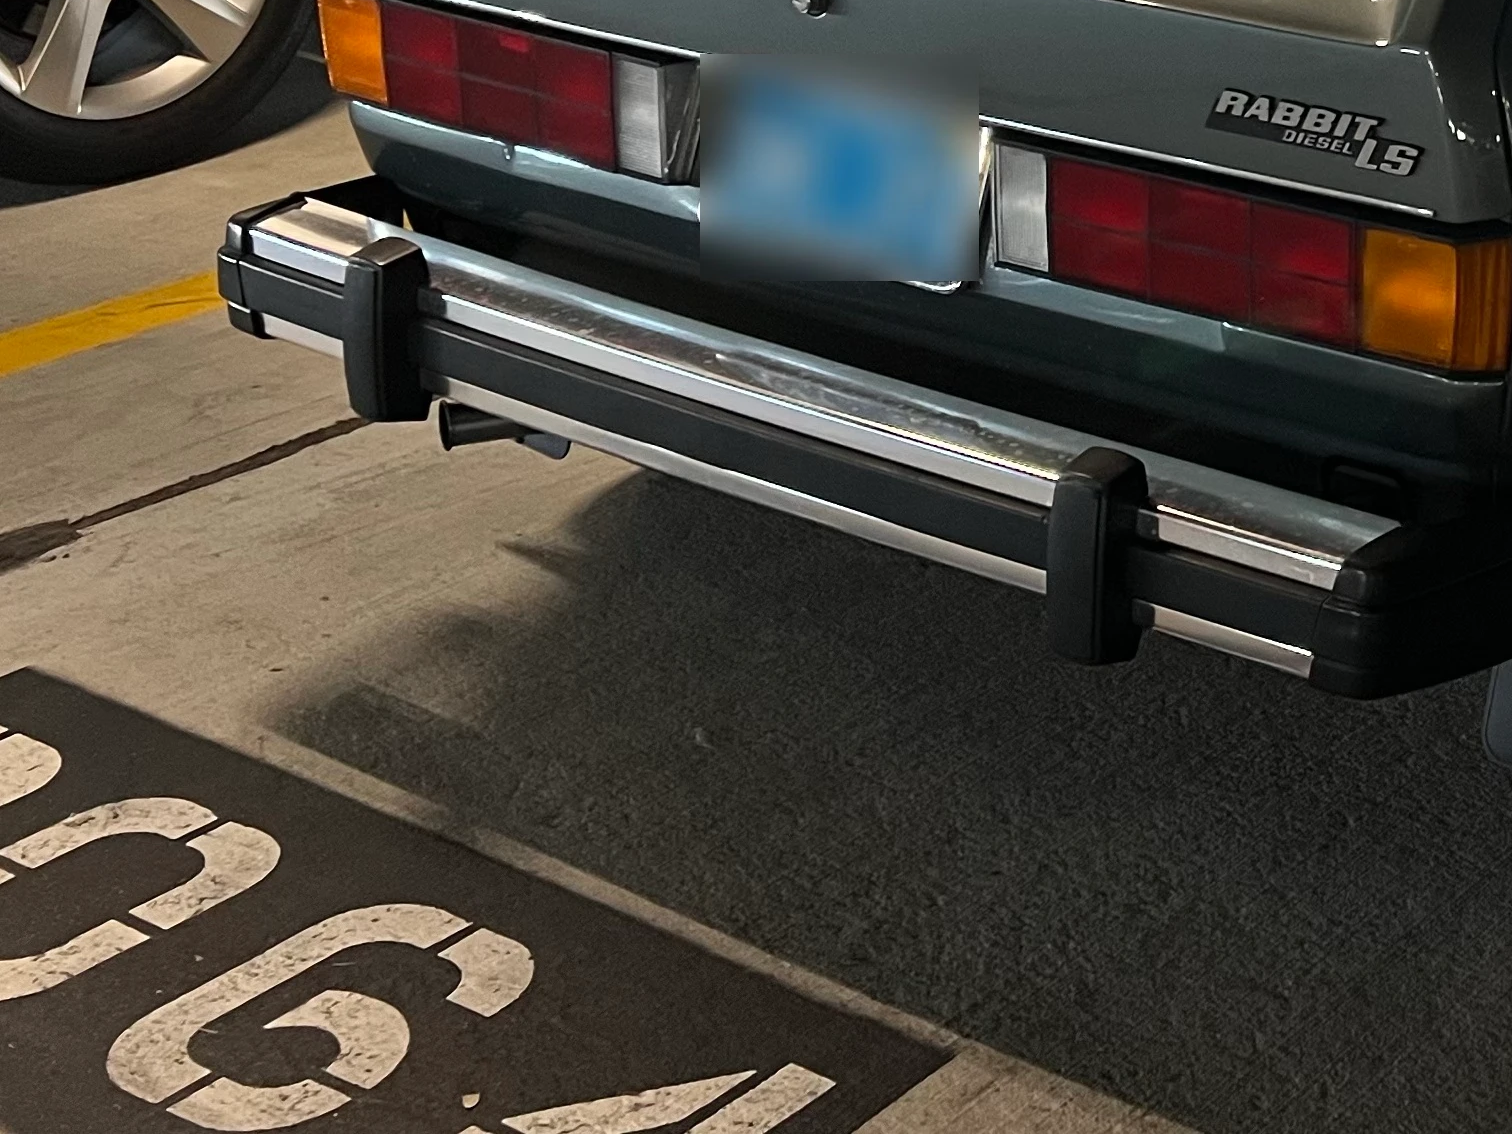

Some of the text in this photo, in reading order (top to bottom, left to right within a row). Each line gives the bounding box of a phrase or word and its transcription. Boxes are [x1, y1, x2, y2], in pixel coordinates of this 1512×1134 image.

[1214, 89, 1379, 142] RABBIT
[1281, 128, 1354, 156] DIESEL
[1353, 137, 1420, 177] LS
